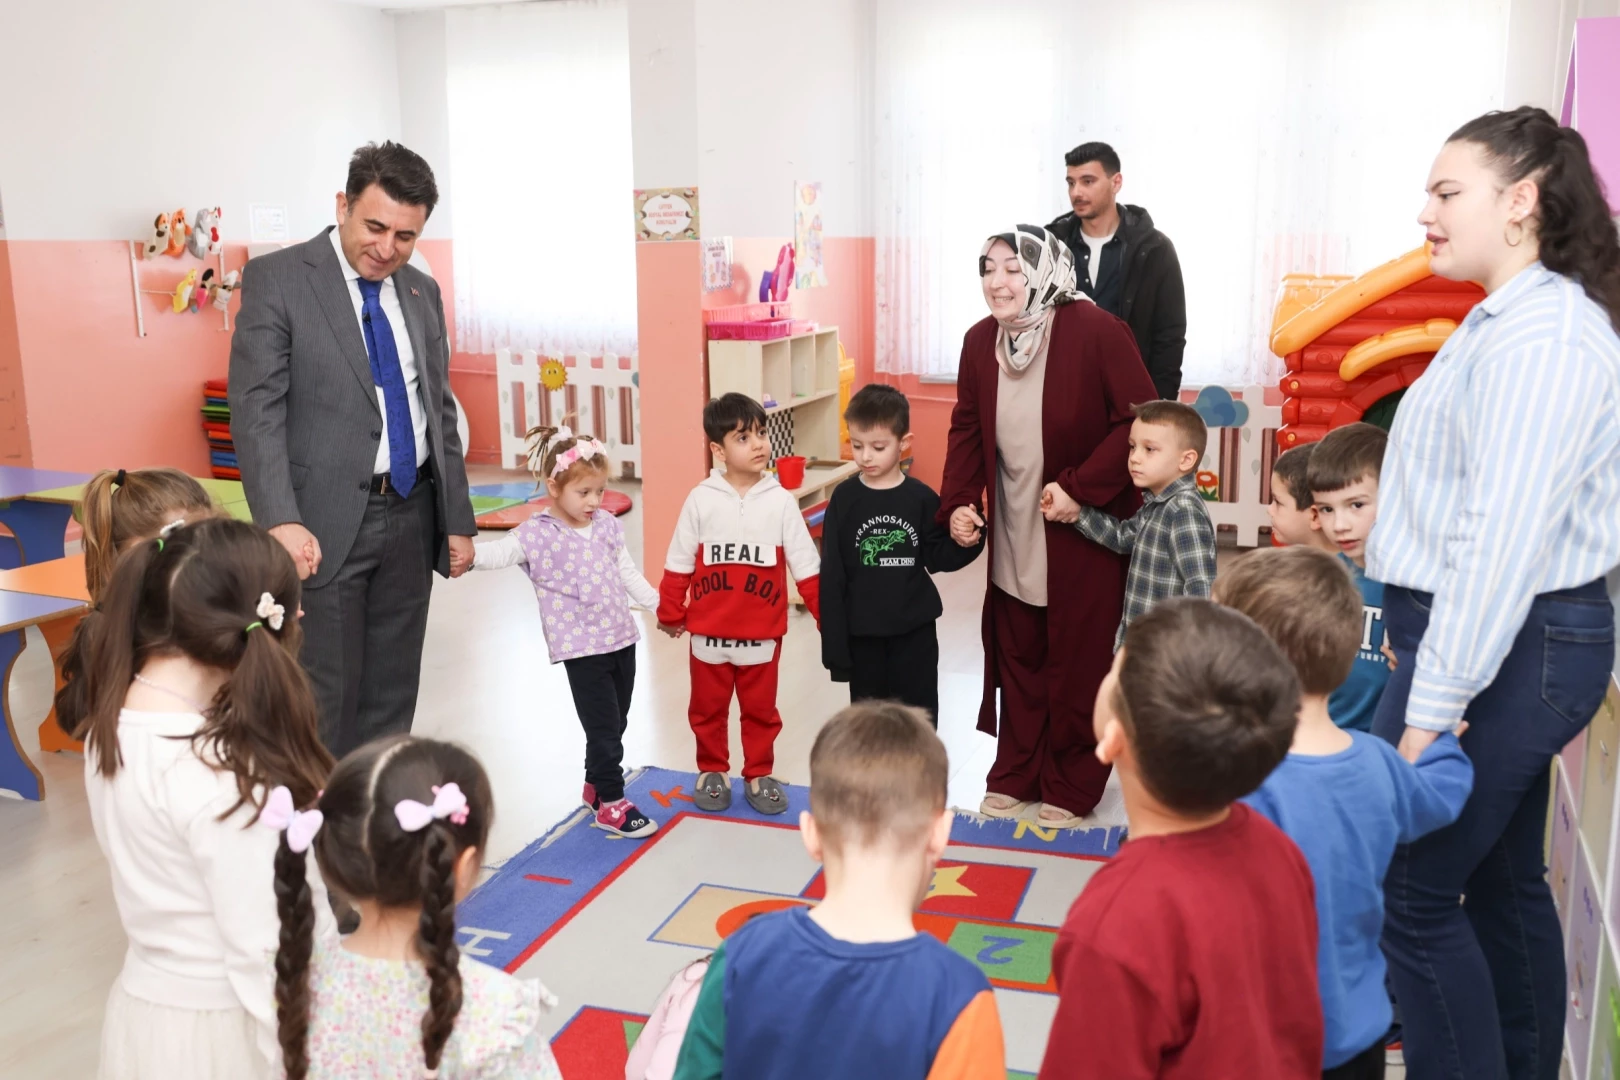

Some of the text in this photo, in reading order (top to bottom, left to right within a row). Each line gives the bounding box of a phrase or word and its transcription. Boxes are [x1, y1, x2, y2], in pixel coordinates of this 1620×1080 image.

[855, 514, 918, 547] TYRANNOSAURUS
[711, 543, 764, 563] REAL
[880, 557, 899, 566] TEAM
[693, 570, 733, 601] COOL
[457, 926, 513, 957] H
